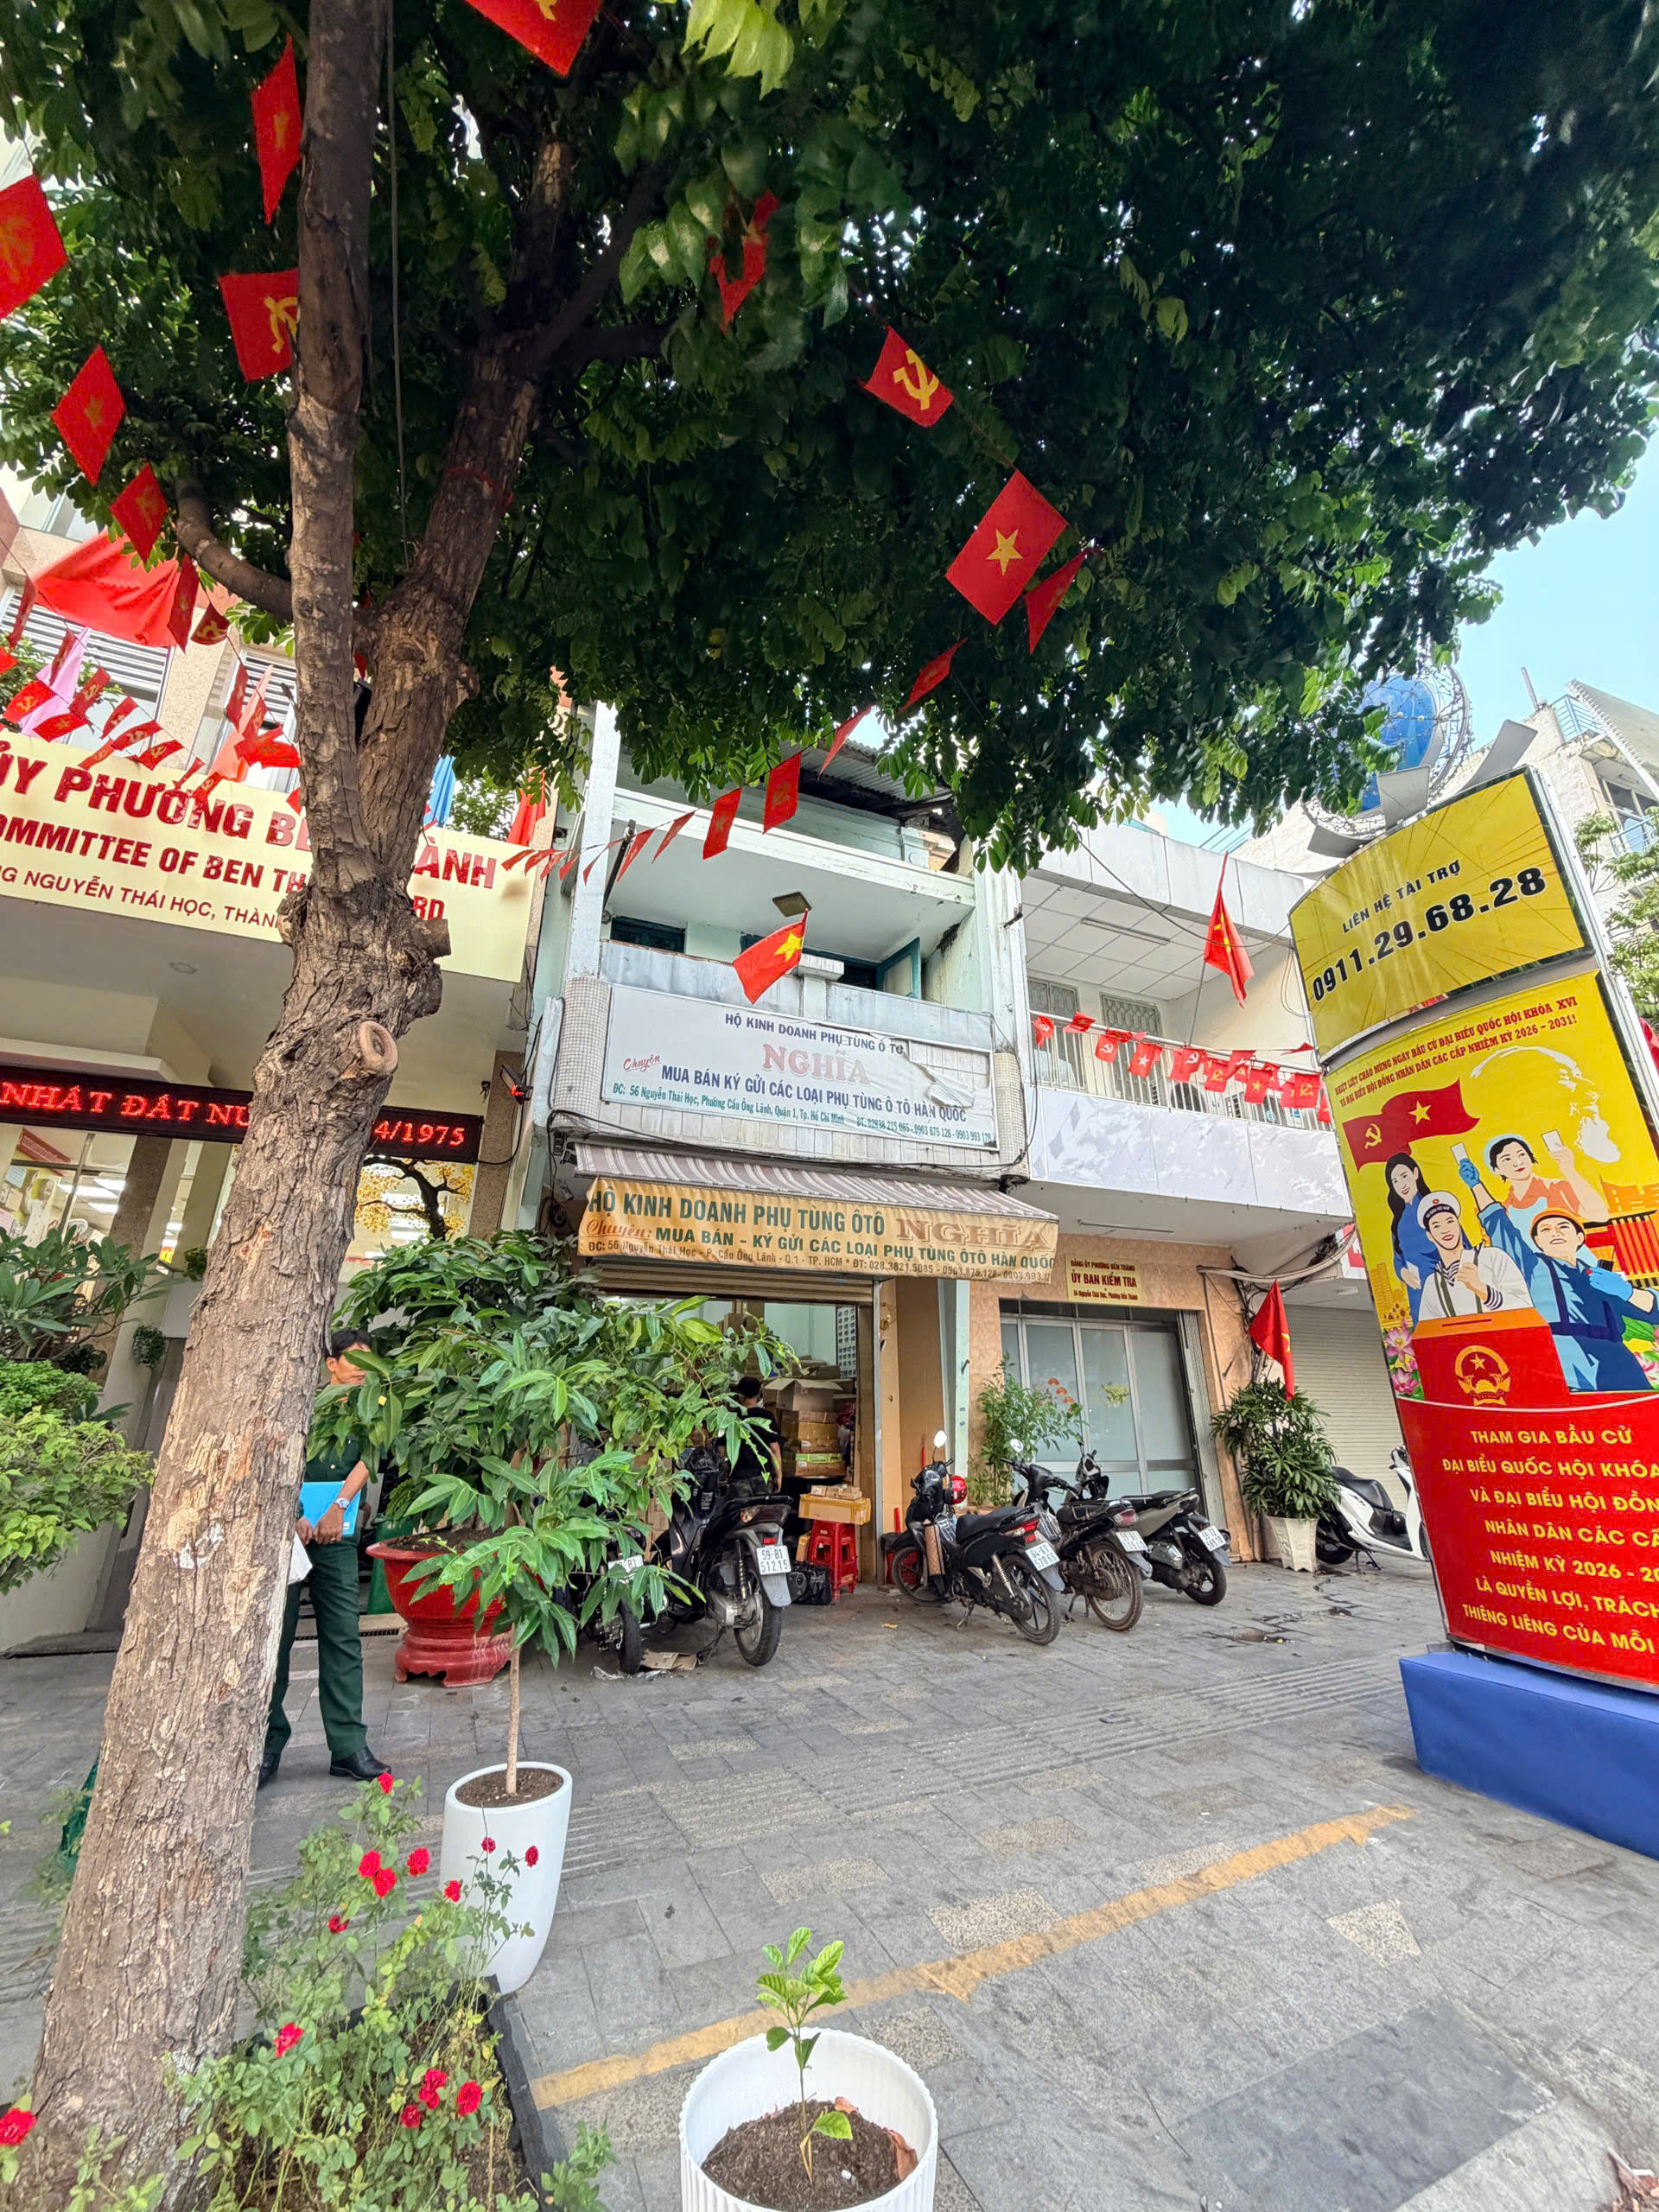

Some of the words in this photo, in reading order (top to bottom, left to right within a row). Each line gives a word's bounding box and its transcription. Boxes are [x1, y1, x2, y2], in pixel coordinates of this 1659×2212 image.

[0, 814, 152, 868] MMITTEE
[158, 847, 199, 874] OF
[203, 855, 264, 888] BEN
[54, 766, 254, 839] PHƯỜNG
[414, 836, 497, 889] ÀNH
[23, 870, 114, 899] NGUYỄN
[121, 887, 167, 908] THÁI
[169, 896, 216, 920] HỌC,
[1342, 908, 1370, 933] LIÊN
[1373, 893, 1392, 912] HỆ
[1396, 879, 1422, 899] TÀI
[1426, 860, 1460, 885] TRỢ
[1313, 868, 1547, 1001] 0911.29.68.28
[725, 1013, 741, 1028] HỘ
[747, 1017, 774, 1032] KINH
[779, 1024, 817, 1040] DOANH
[821, 1031, 842, 1046] PHỤ
[847, 1035, 875, 1051] TÙNG
[878, 1039, 886, 1052] Ô
[1392, 1049, 1410, 1066] NGÀY
[1439, 1034, 1454, 1050] ĐẠI
[1477, 1016, 1503, 1034] QUỐC
[1503, 1012, 1522, 1026] HỘI
[1523, 1002, 1554, 1020] KHÓA
[1555, 995, 1579, 1010] XVI
[1395, 1064, 1414, 1079] NHÂN
[1415, 1058, 1432, 1072] DÂN
[1433, 1050, 1449, 1065] CÁC
[1467, 1034, 1499, 1054] NHIỆM
[1500, 1029, 1513, 1045] KỲ
[1515, 1024, 1538, 1039] 2026
[1548, 1014, 1577, 1030] 2031!
[623, 1053, 661, 1072] Chuyên
[763, 1043, 871, 1087] NGHĨA
[613, 1083, 626, 1094] ĐC:
[629, 1084, 639, 1096] 56
[641, 1085, 666, 1103] Nguyễn
[668, 1090, 683, 1102] Thái
[684, 1091, 699, 1106] Học,
[701, 1094, 726, 1110] Phường
[741, 1097, 754, 1114] Ông
[755, 1102, 773, 1116] Lãnh,
[774, 1105, 791, 1120] Quận
[830, 1111, 844, 1124] Minh
[887, 1120, 898, 1131] 215
[930, 1125, 940, 1136] 875
[956, 1128, 969, 1140] 0903
[662, 1065, 690, 1083] MUA
[694, 1068, 720, 1088] BÁN
[724, 1072, 741, 1090] KÝ
[745, 1074, 766, 1094] GỬI
[769, 1080, 793, 1098] CÁC
[797, 1086, 823, 1104] LOẠI
[826, 1090, 849, 1109] PHỤ
[853, 1091, 882, 1111] TÙNG
[885, 1096, 893, 1112] Ô
[896, 1098, 911, 1115] TÔ
[914, 1101, 936, 1118] HÀN
[586, 1219, 652, 1239] Chuyên:
[655, 1227, 695, 1243] MUA
[701, 1227, 734, 1246] BÁN
[753, 1232, 772, 1249] KÝ
[778, 1234, 804, 1251] GỬI
[810, 1237, 841, 1253] CÁC
[847, 1242, 878, 1258] LOẠI
[884, 1245, 913, 1262] PHỤ
[918, 1245, 955, 1262] TÙNG
[960, 1247, 987, 1263] ÔTÔ
[991, 1251, 1016, 1267] HÀN
[589, 1186, 616, 1217] HỘ
[623, 1193, 672, 1217] KINH
[679, 1198, 747, 1224] DOANH
[753, 1205, 791, 1232] PHỤ
[798, 1205, 845, 1232] TÙNG
[851, 1209, 885, 1236] ÔTÔ
[896, 1218, 1055, 1252] NGHĨA
[588, 1242, 605, 1252] ĐC:
[607, 1240, 619, 1250] 56
[658, 1244, 677, 1255] Thái
[680, 1247, 696, 1258] Học
[737, 1248, 753, 1263] Ông
[756, 1252, 776, 1262] Lãnh
[809, 1255, 821, 1266] TP.
[824, 1256, 842, 1267] HCM
[853, 1259, 867, 1269] ĐT:
[869, 1261, 933, 1274] 028.3821.5085
[1071, 1268, 1081, 1283] ỦY
[1084, 1274, 1100, 1285] BAN
[1102, 1271, 1121, 1287] KIỂM
[1122, 1276, 1137, 1287] TRA
[1470, 1431, 1514, 1444] THAM
[1517, 1431, 1551, 1444] GIA
[1555, 1423, 1595, 1445] BẦU
[1601, 1425, 1632, 1445] CỬ
[1442, 1459, 1464, 1475] ĐẠI
[1466, 1453, 1497, 1473] BIỂU
[1500, 1456, 1553, 1475] QUỐC
[1557, 1459, 1595, 1480] HỘI
[1470, 1486, 1491, 1503] VÀ
[1493, 1491, 1522, 1508] ĐẠI
[1525, 1486, 1563, 1507] BIỂU
[1568, 1491, 1606, 1513] HỘI
[1484, 1518, 1529, 1537] NHÂN
[1533, 1522, 1573, 1541] DÂN
[1577, 1525, 1625, 1545] CÁC
[1491, 1549, 1539, 1571] NHIỆM
[1543, 1554, 1566, 1573] KỲ
[1573, 1560, 1622, 1579] 2026
[1475, 1575, 1493, 1593] LÀ
[1496, 1580, 1548, 1603] QUYỀN
[1551, 1590, 1589, 1611] LỢI,
[1462, 1604, 1508, 1625] THIÊNG
[1511, 1613, 1558, 1636] LIÊNG
[1562, 1622, 1606, 1645] CỦA
[1610, 1629, 1656, 1654] MỖI
